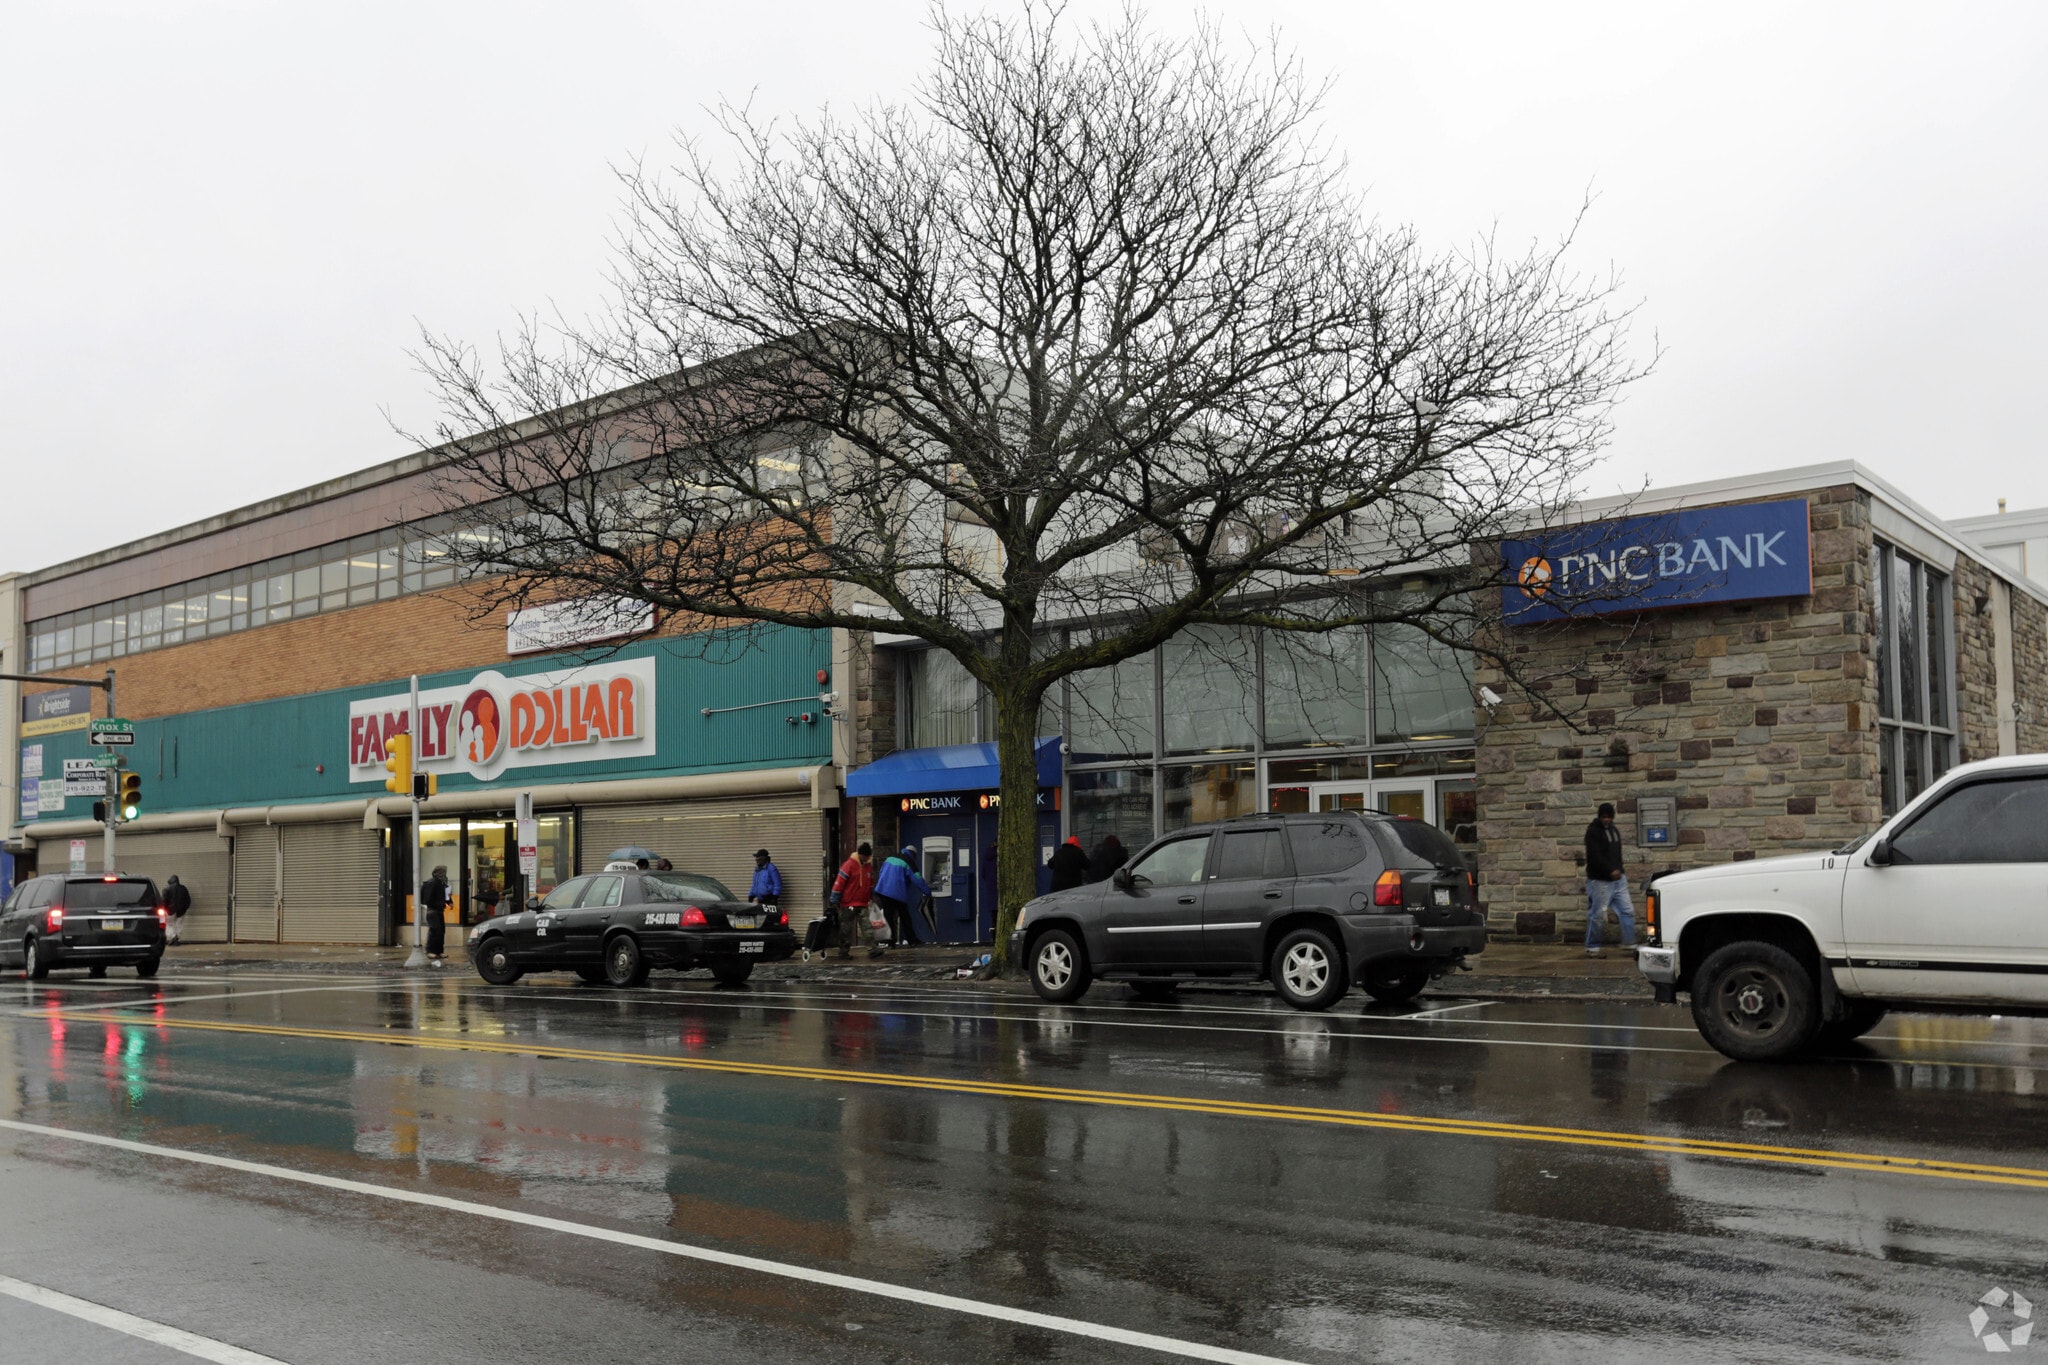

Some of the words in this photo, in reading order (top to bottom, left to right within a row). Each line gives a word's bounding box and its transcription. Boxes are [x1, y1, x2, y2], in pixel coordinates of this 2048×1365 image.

[1558, 546, 1649, 590] PNC
[1659, 530, 1787, 577] BANK
[509, 677, 634, 748] DOLLAR
[91, 722, 119, 731] Knox
[122, 723, 134, 731] St
[67, 761, 94, 769] LEA
[910, 797, 930, 810] PNC
[931, 796, 961, 809] BANK
[1821, 857, 1835, 870] 10
[762, 903, 777, 913] G-127
[536, 919, 550, 928] CAB
[536, 927, 547, 937] CO.
